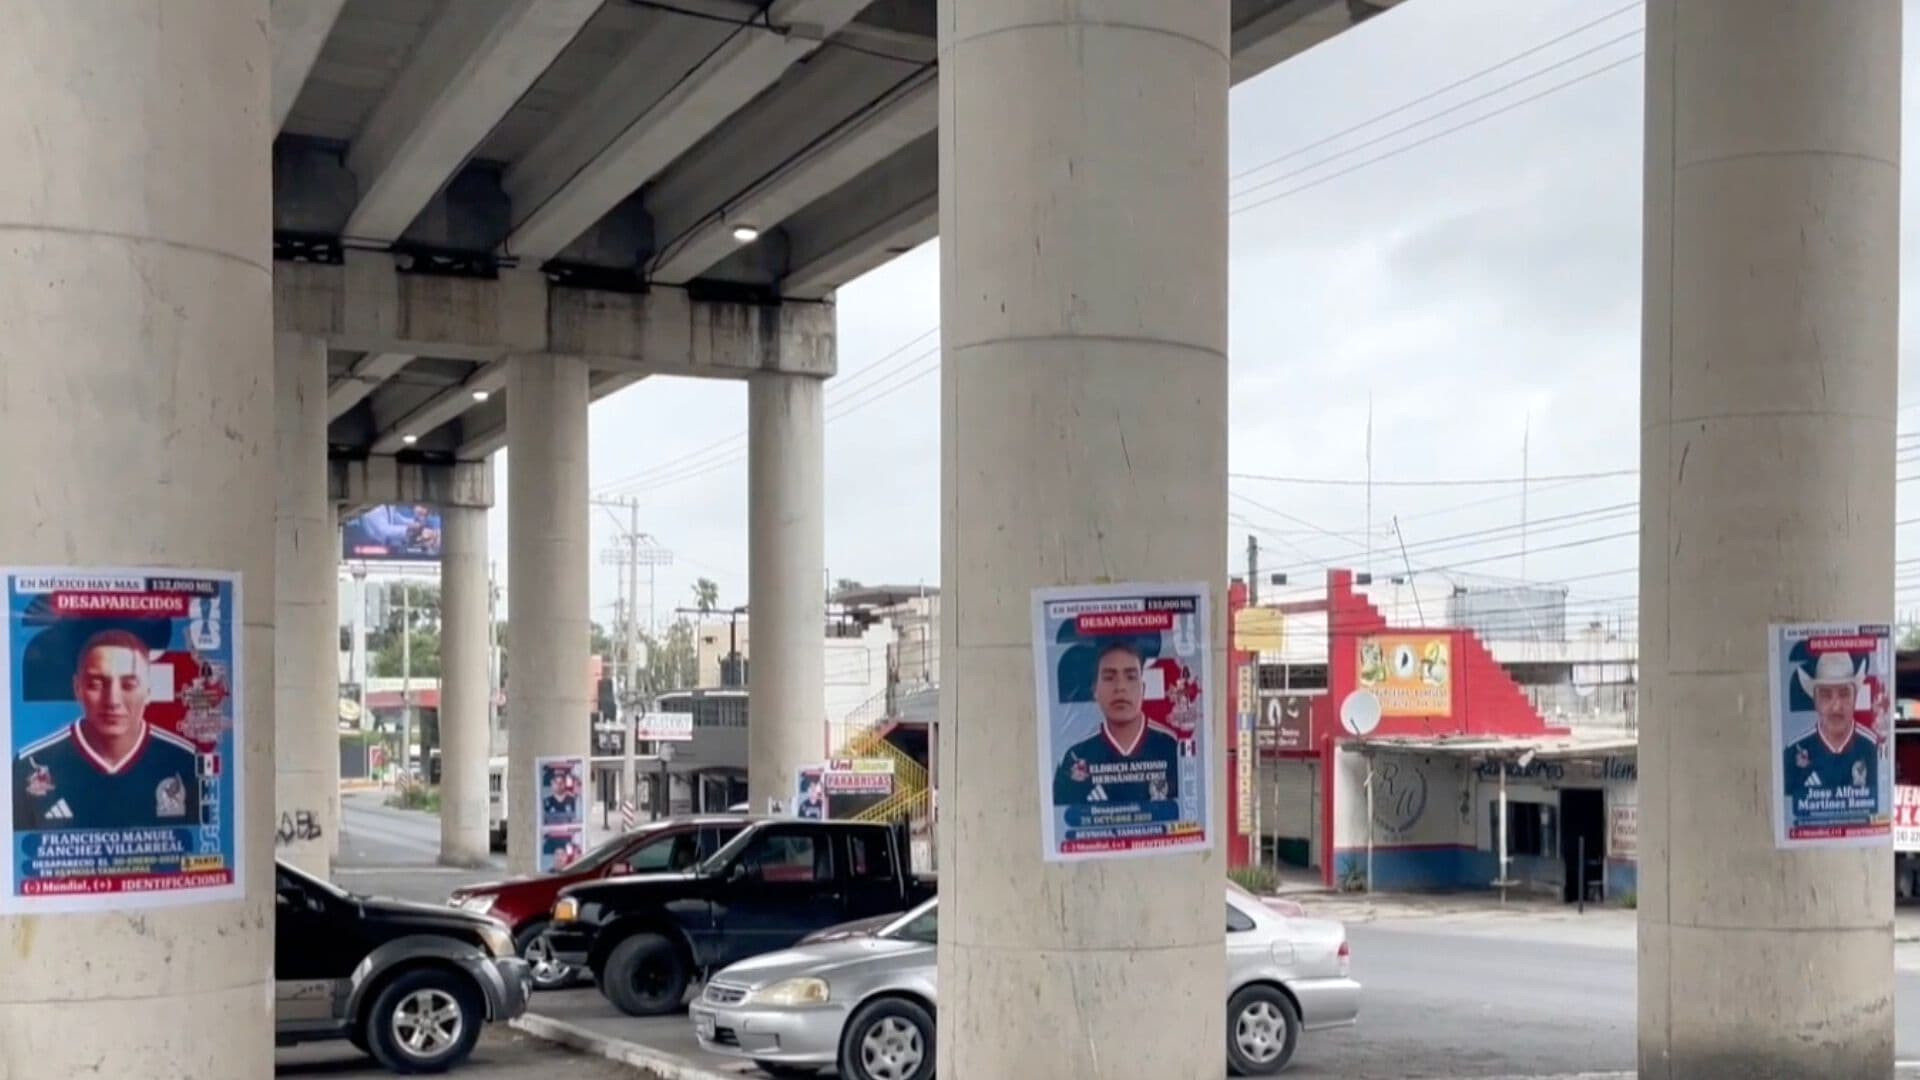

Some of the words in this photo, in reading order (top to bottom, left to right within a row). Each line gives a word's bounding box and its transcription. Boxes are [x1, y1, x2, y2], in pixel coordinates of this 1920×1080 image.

[20, 579, 36, 590] EN
[39, 577, 86, 590] MÉXICO
[87, 580, 112, 591] HAY
[58, 594, 183, 611] DESAPARECIDOS
[1080, 614, 1168, 629] DESAPARECIDOS
[1129, 760, 1168, 772] ANTONIO
[42, 832, 120, 846] FRANCISCO
[122, 829, 176, 843] MANUEL
[105, 840, 185, 855] VILLARREAL
[42, 880, 92, 892] Mundial,
[121, 872, 228, 890] IDENTIFICACIONES
